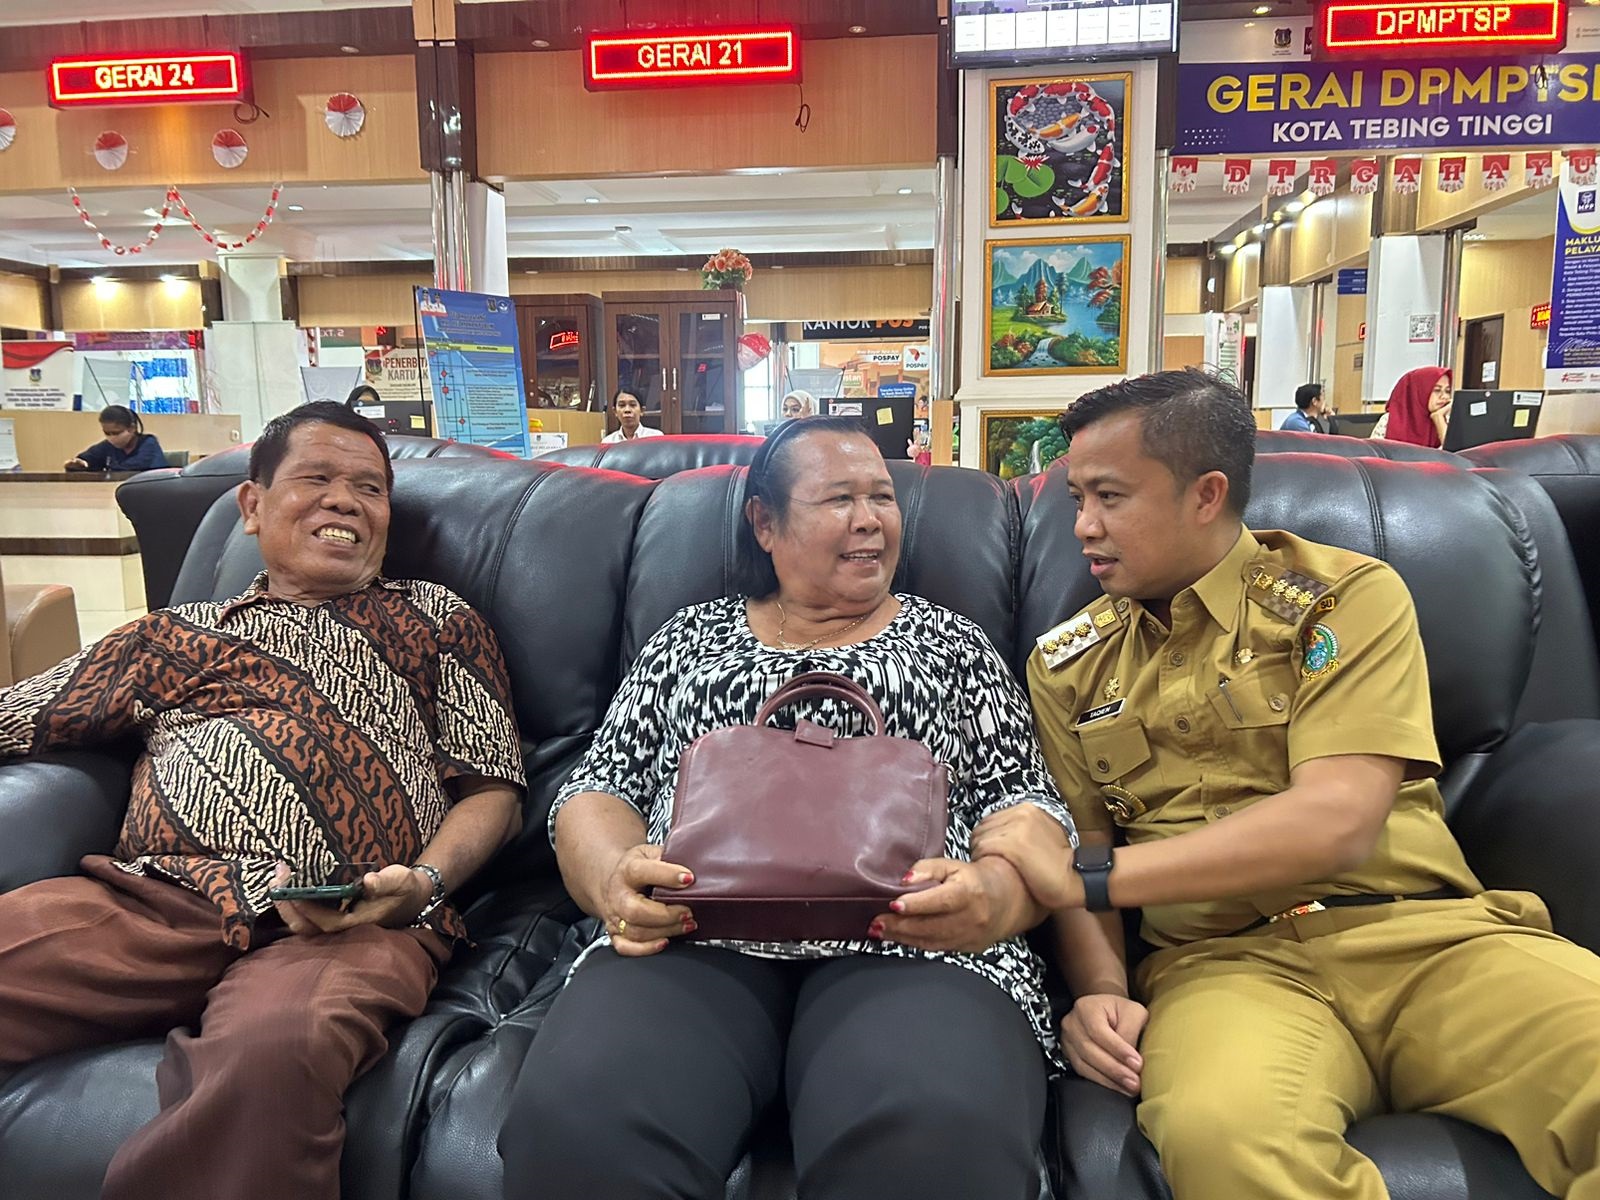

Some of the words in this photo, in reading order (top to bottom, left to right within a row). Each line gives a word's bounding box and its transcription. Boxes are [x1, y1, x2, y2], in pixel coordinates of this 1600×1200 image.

[1376, 7, 1511, 35] DPMPTSP
[637, 42, 711, 68] GERAI
[718, 40, 743, 65] 21
[95, 64, 163, 89] GERAI
[168, 64, 194, 86] 24
[1206, 70, 1364, 114] GERAI
[1380, 63, 1600, 107] DPMPTS
[1272, 120, 1343, 143] KOTA
[1350, 116, 1450, 140] TEBING
[1457, 113, 1553, 137] TINGGI
[387, 369, 416, 380] KARTU
